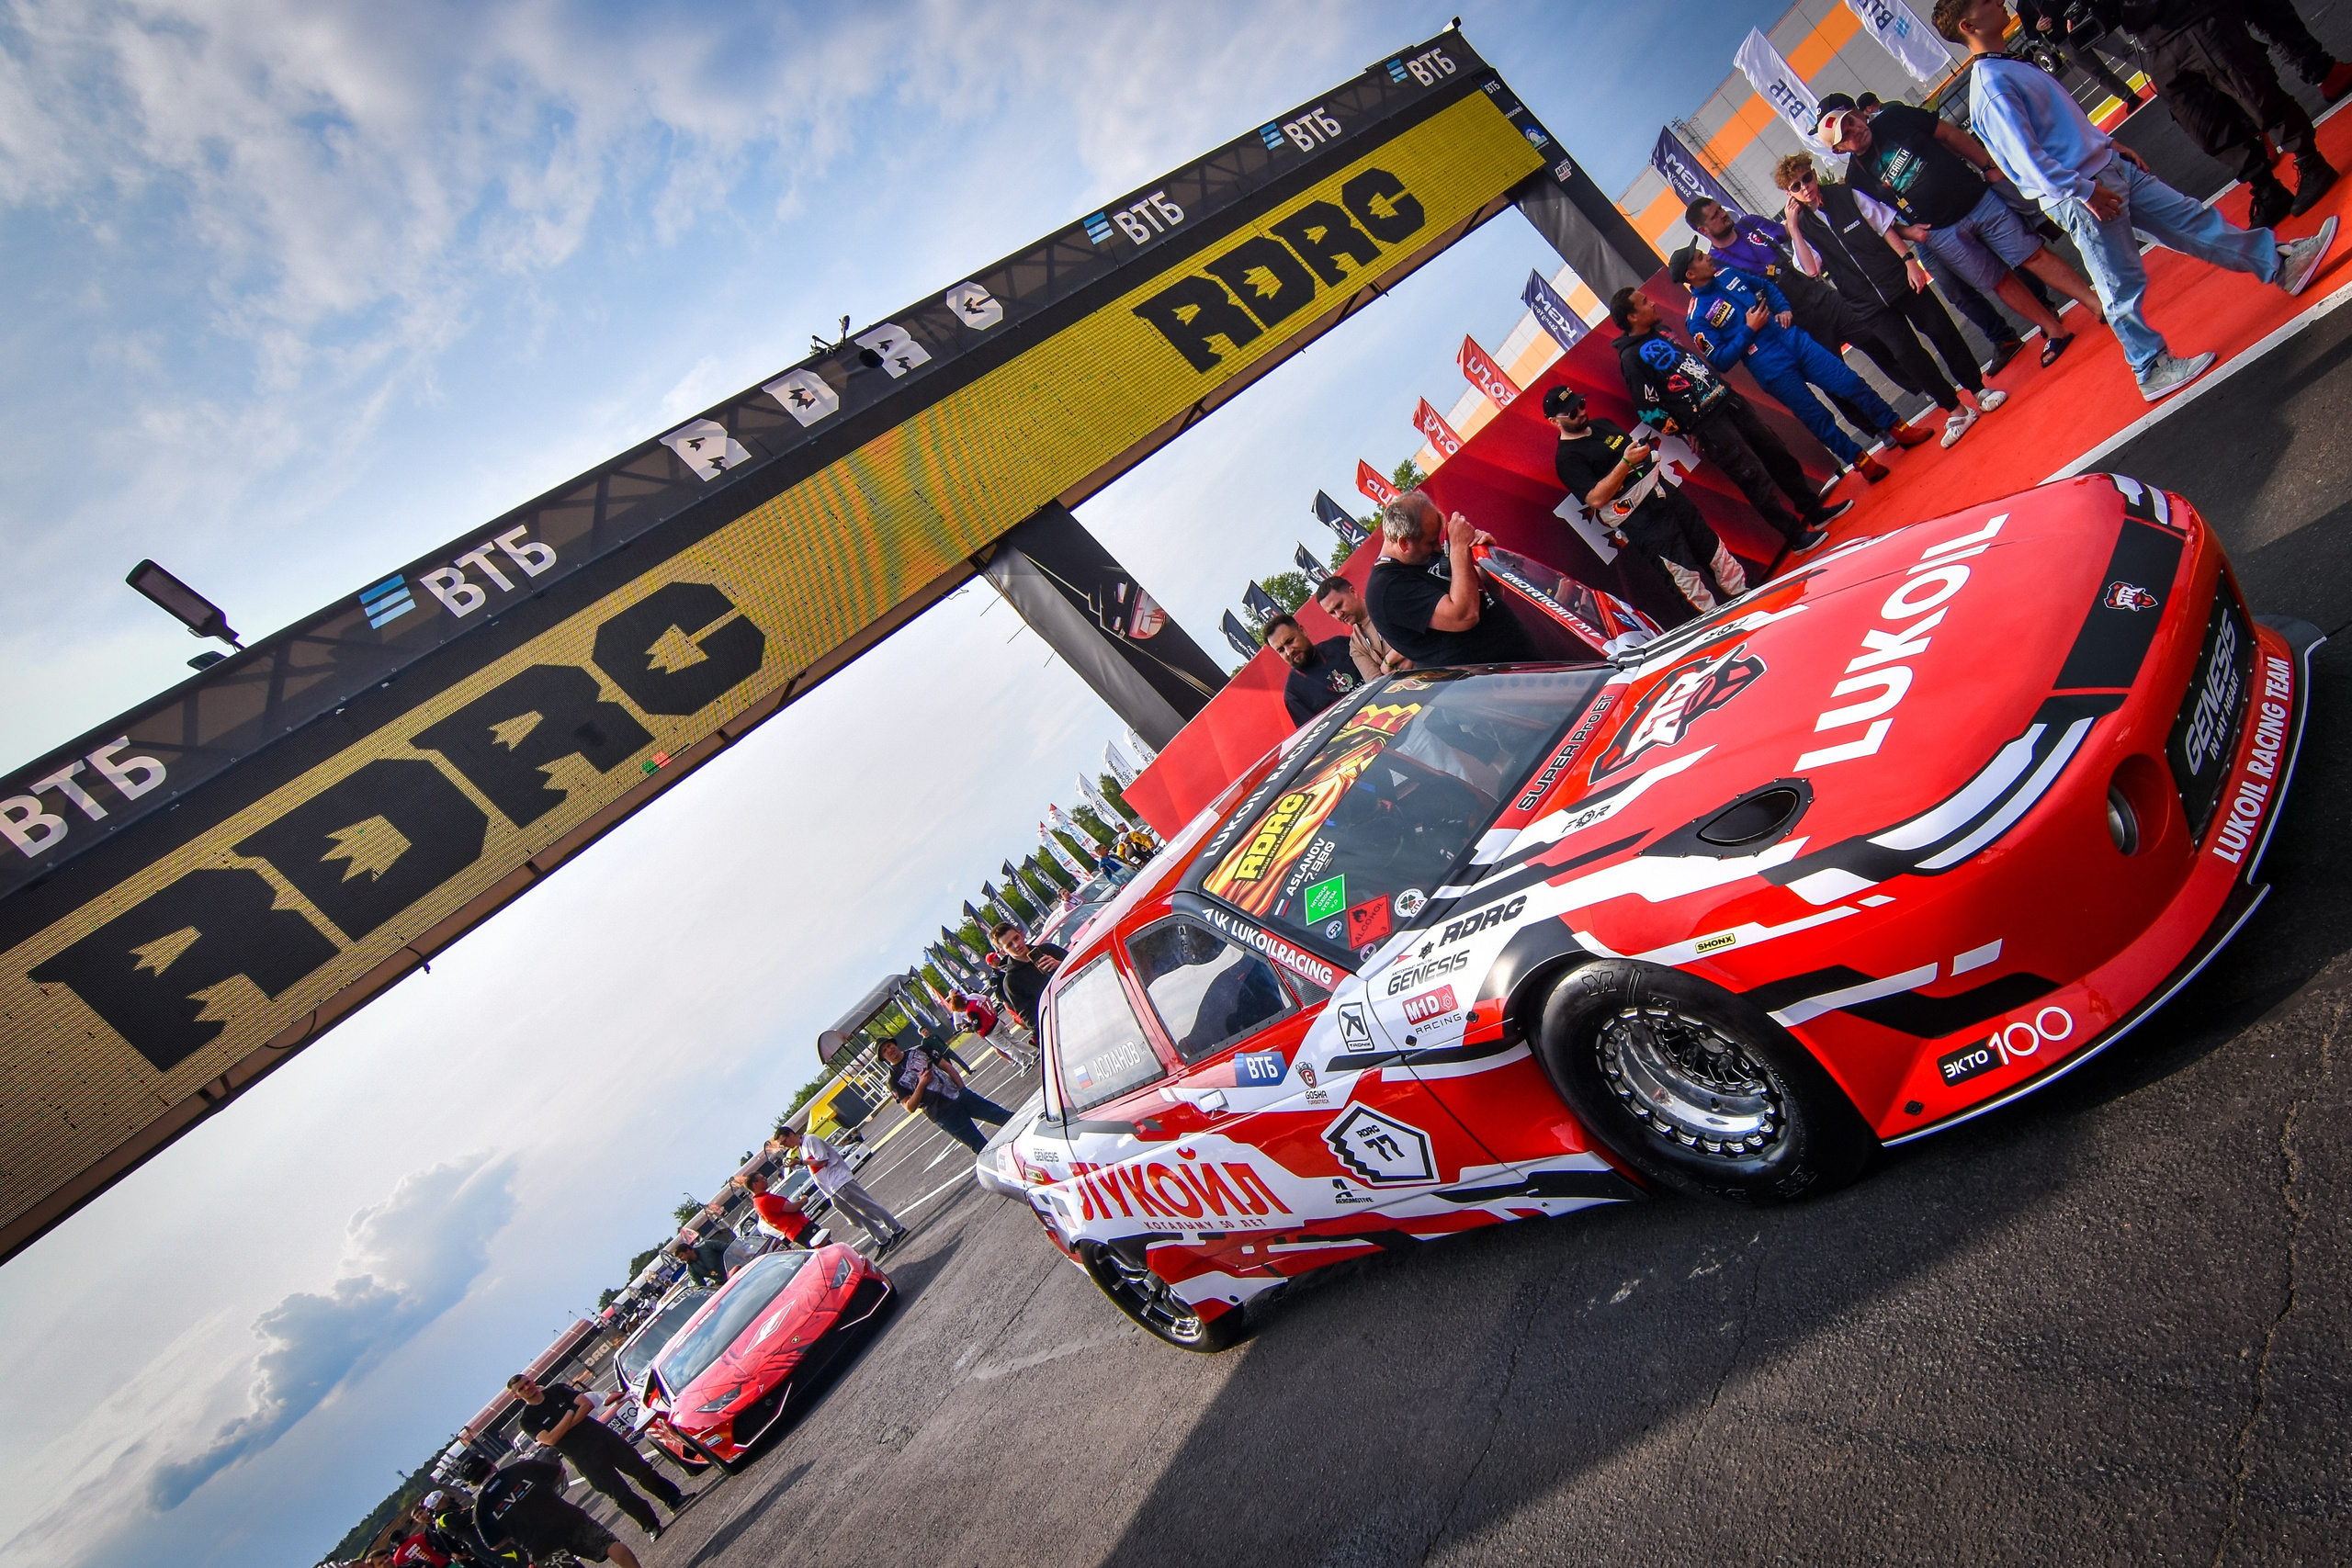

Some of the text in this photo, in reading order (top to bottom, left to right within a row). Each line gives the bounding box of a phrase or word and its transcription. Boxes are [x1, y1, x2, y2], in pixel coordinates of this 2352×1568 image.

[1408, 48, 1456, 86] ВТБ
[1484, 80, 1501, 94] ВТБ
[1283, 107, 1341, 152] ВТБ
[1114, 191, 1184, 245] ВТБ
[1132, 168, 1425, 374] RDRC
[420, 525, 557, 618] ВТБ
[1792, 513, 2011, 773] LUKOIL
[2185, 608, 2236, 776] GENESIS
[2208, 668, 2240, 761] IN MY HEART
[1517, 743, 1580, 811] SUPER
[2211, 656, 2290, 864] LUKOIL RACING TEAM
[0, 735, 168, 858] ВТБ
[1203, 785, 1270, 859] LUKOIL
[1266, 720, 1330, 784] RACING
[26, 582, 765, 1071] RDRC
[1235, 794, 1305, 879] RDRC
[1286, 838, 1325, 897] ASLANOV
[1310, 886, 1329, 908] NITROUS
[1317, 891, 1331, 908] OXIDE
[1320, 890, 1338, 911] SYSTEM
[1355, 902, 1385, 943] ALCOHOL
[1439, 895, 1528, 947] RDRC
[1697, 936, 1734, 952] SHONX
[1387, 949, 1470, 997] GENESIS
[1405, 995, 1441, 1022] M1D
[1416, 1014, 1462, 1035] RACING
[1093, 1042, 1141, 1081] АСЛАНОВ
[1943, 1006, 2074, 1078] ЭКТО 100
[1246, 1056, 1278, 1079] ВТБ
[1306, 1090, 1328, 1100] GOSHA
[1355, 1124, 1381, 1138] RDRC
[1363, 1134, 1406, 1162] 77
[1035, 1151, 1059, 1162] GENESIS
[1068, 1146, 1294, 1221] ЛУКОЙЛ
[1335, 1196, 1374, 1205] AEROMOTIVE
[1144, 1218, 1266, 1230] КОГАЛЫМУ 50 ЛЕТ
